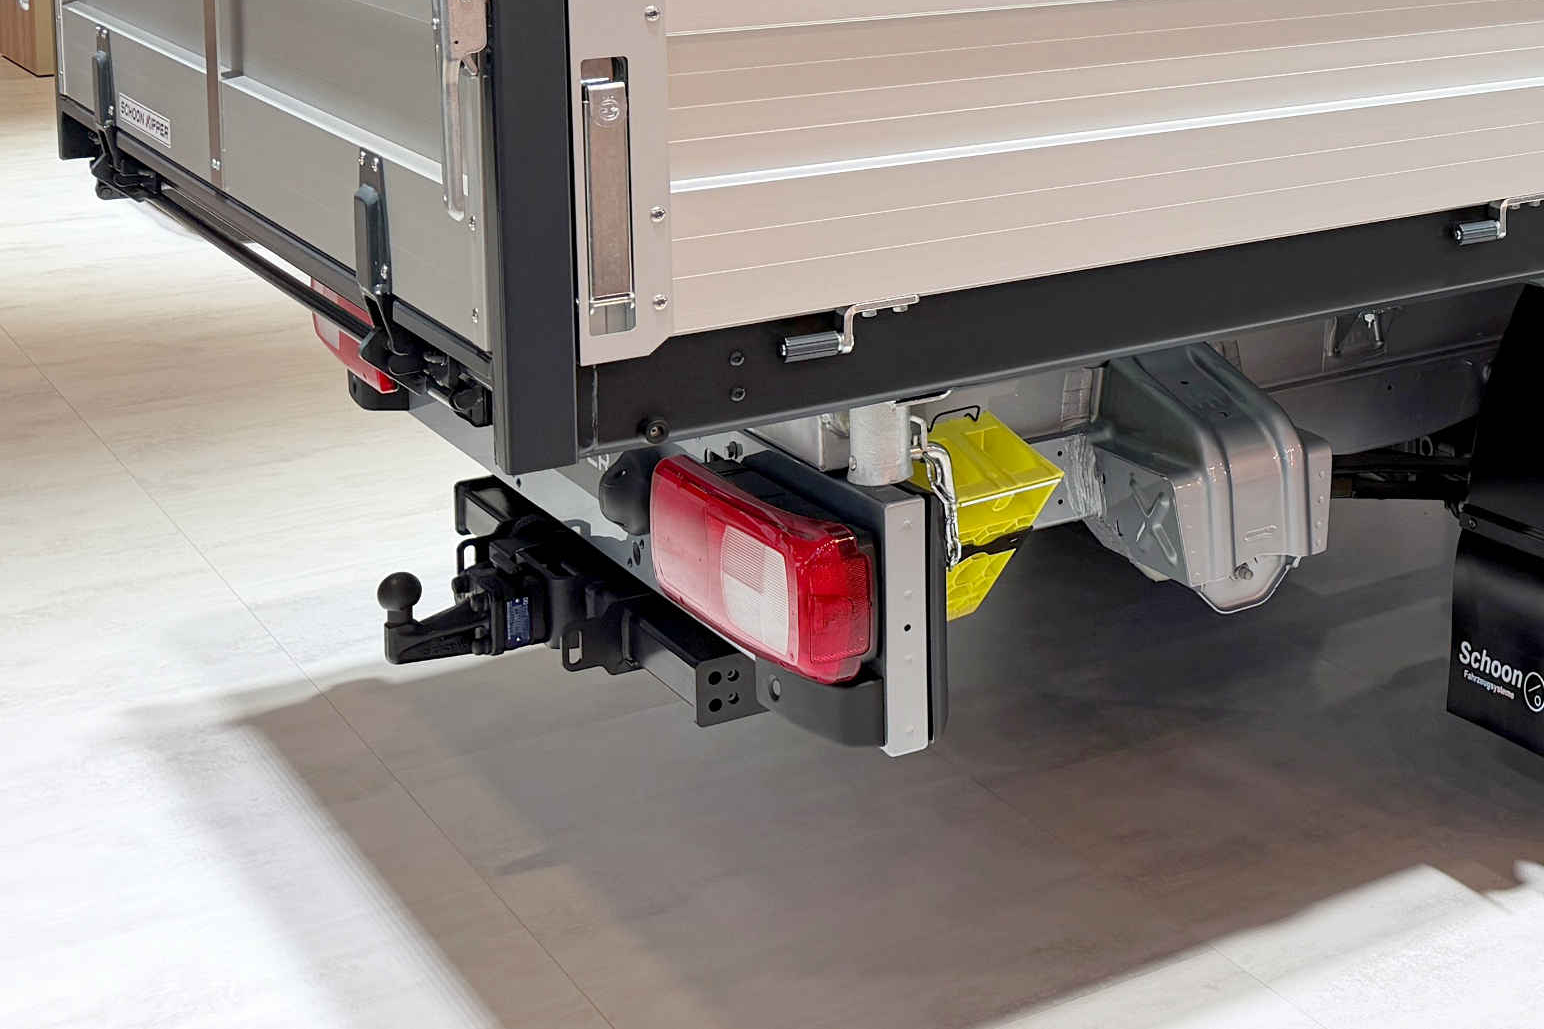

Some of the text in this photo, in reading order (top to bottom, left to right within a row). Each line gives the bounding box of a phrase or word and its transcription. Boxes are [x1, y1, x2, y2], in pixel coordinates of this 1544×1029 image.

[120, 100, 169, 140] SCHOON KIPPER
[1459, 640, 1524, 688] Schoon
